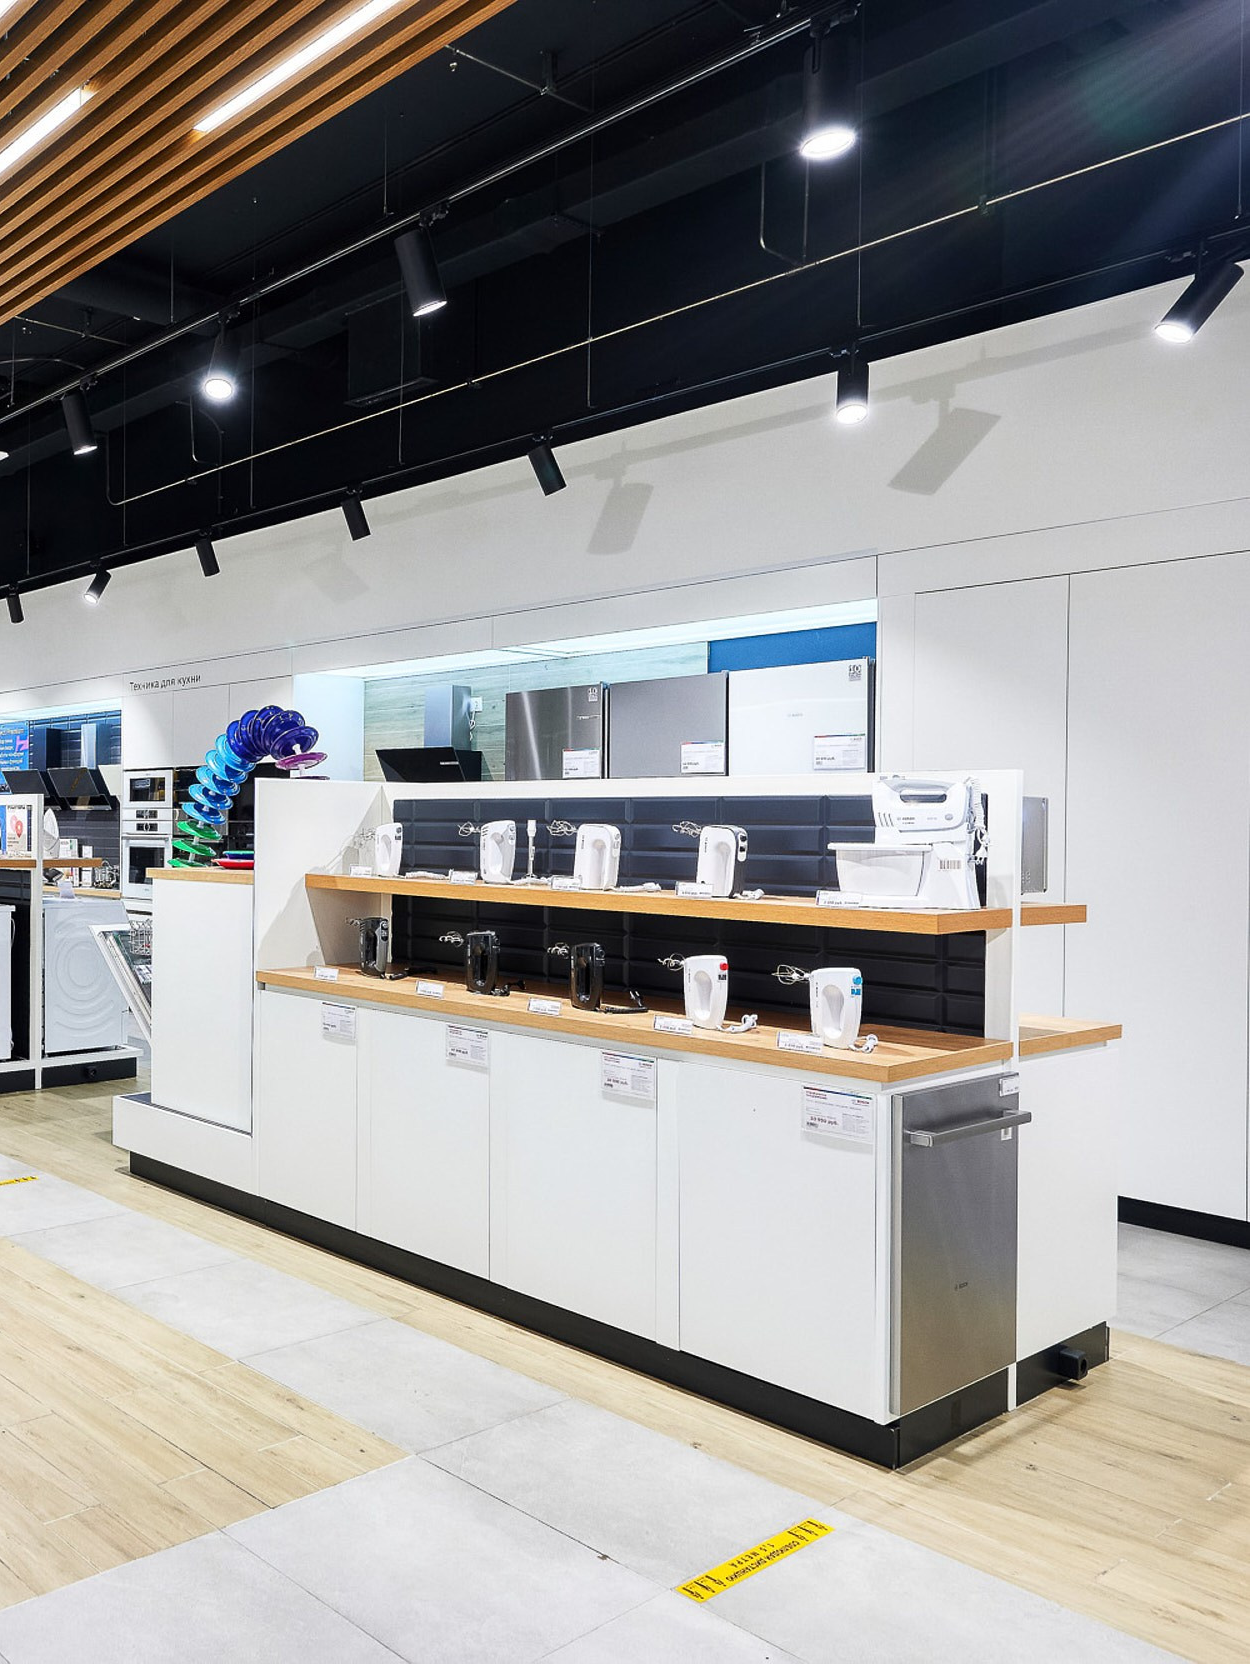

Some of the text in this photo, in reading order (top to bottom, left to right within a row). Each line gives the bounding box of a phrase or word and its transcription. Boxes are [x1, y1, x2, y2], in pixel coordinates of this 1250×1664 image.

[130, 675, 201, 691] Техника для кухни
[729, 1551, 760, 1569] МЕТРА
